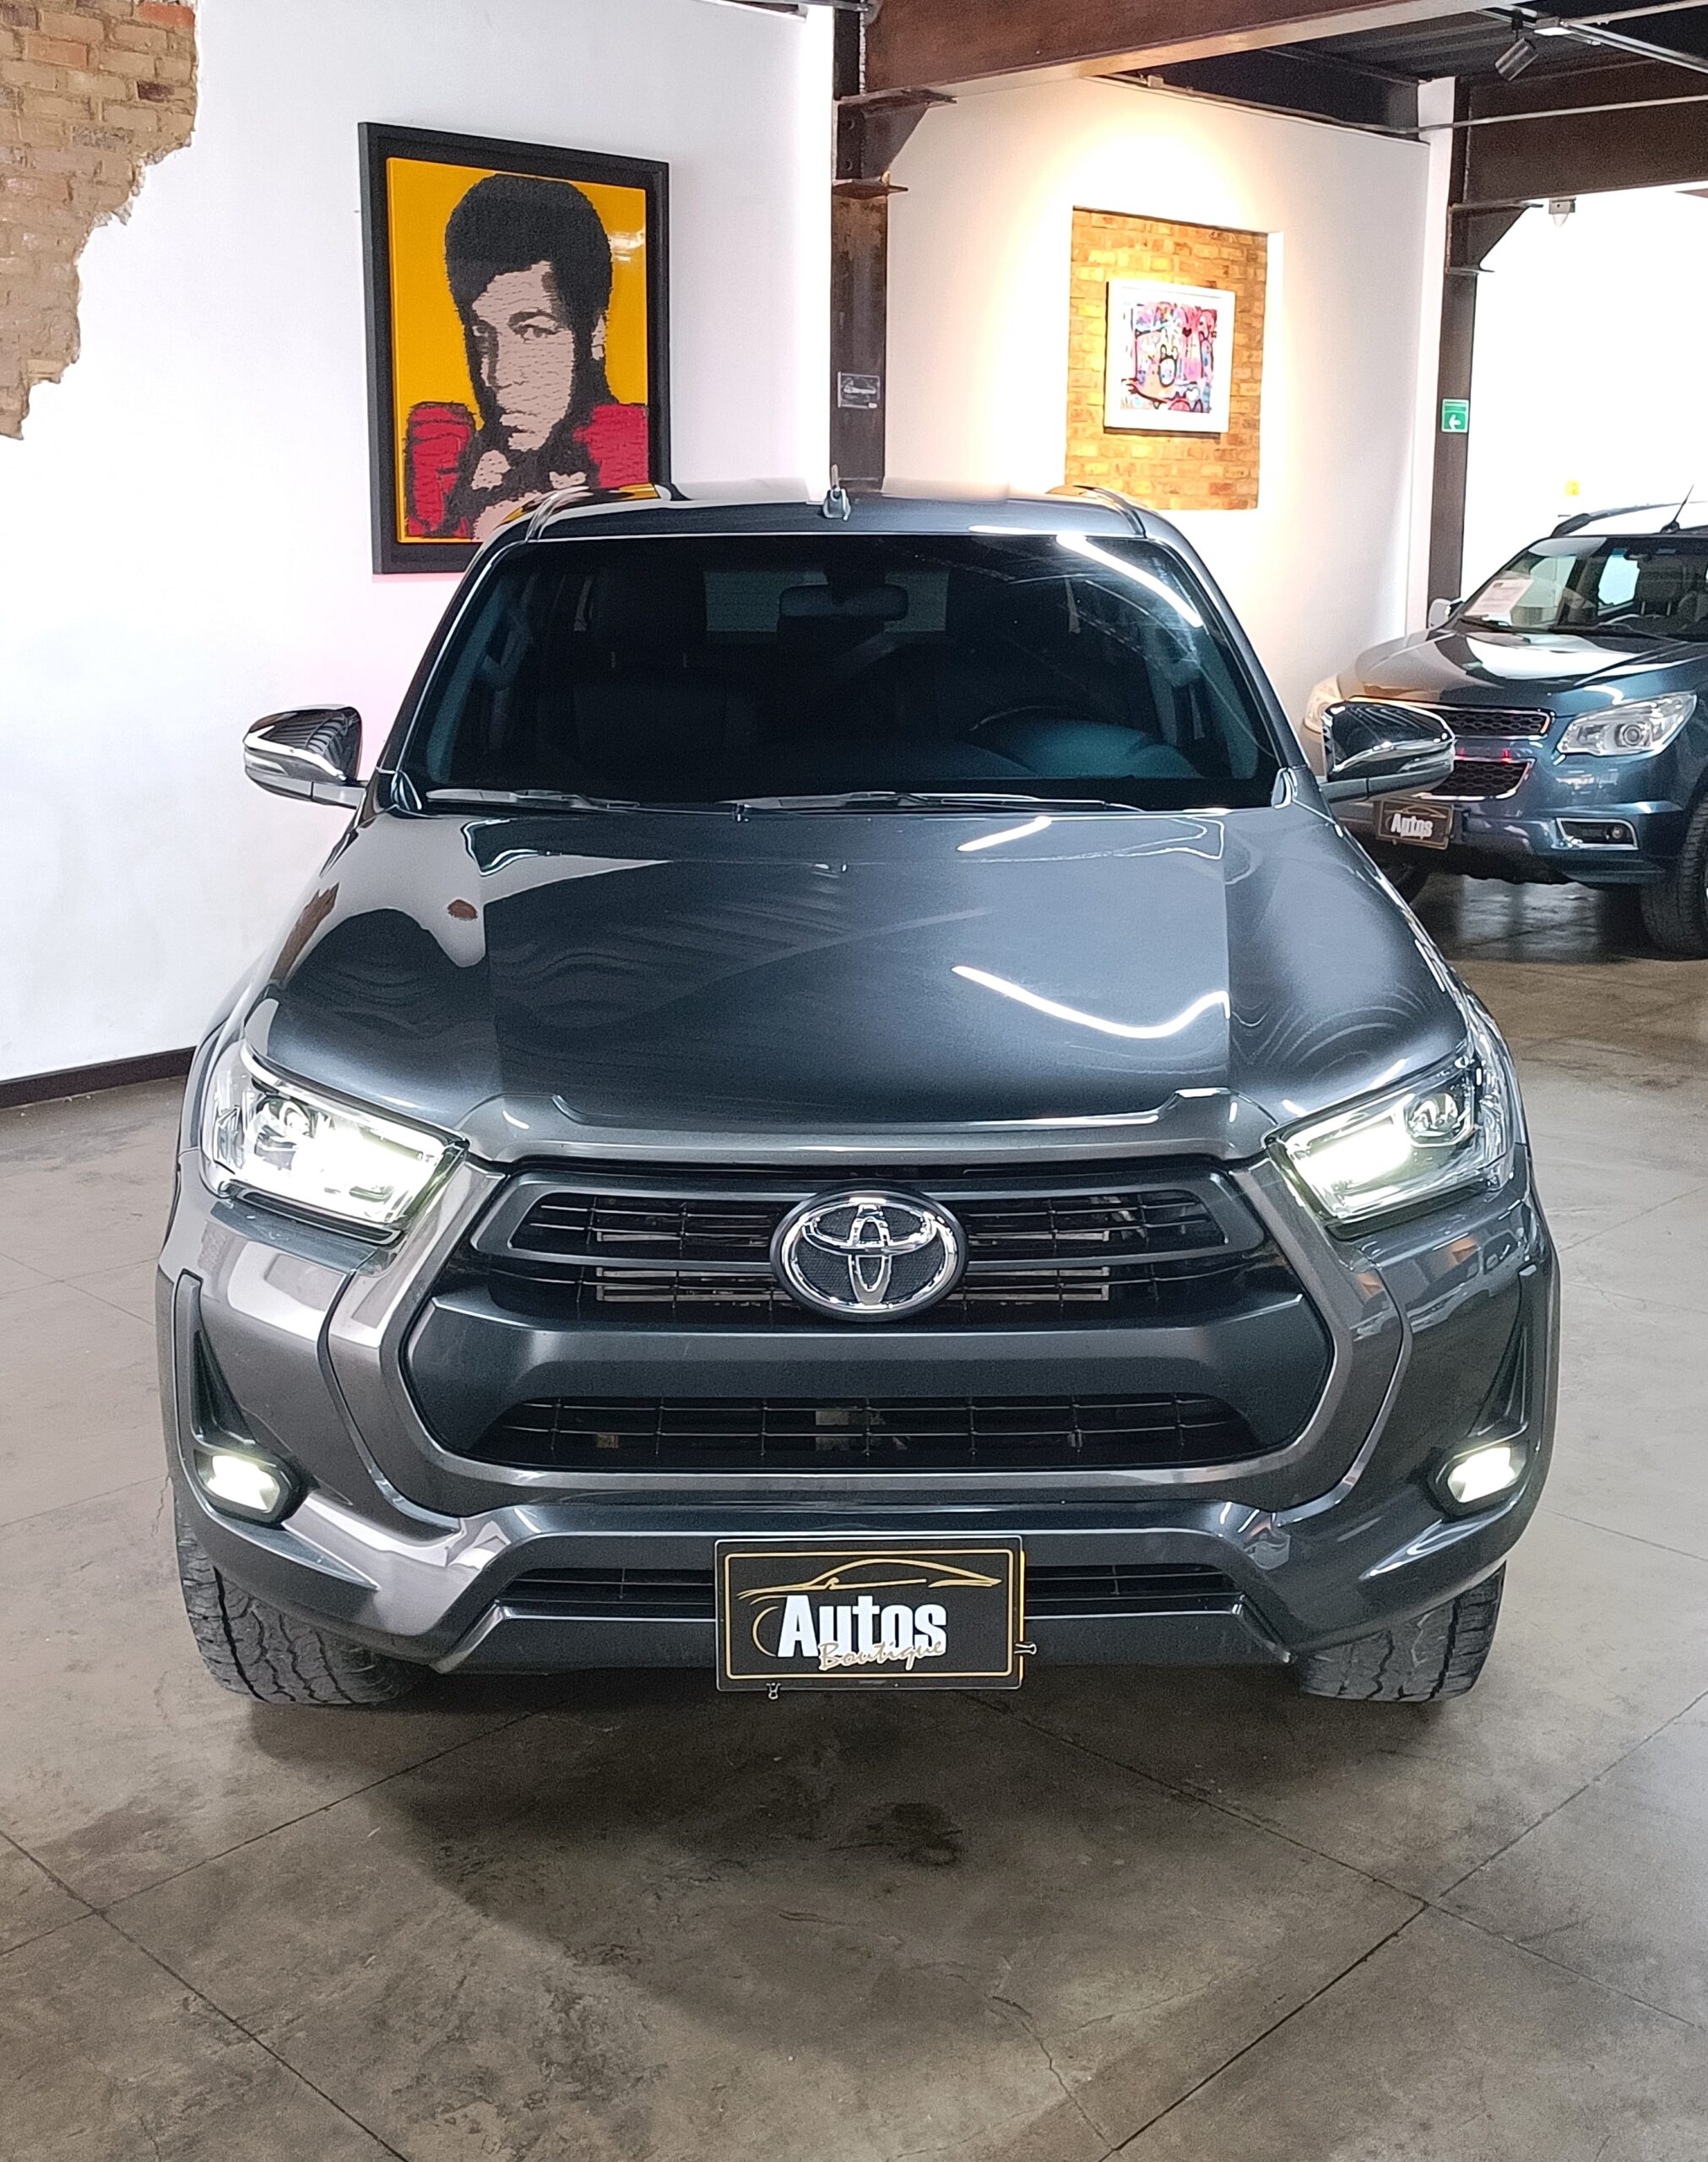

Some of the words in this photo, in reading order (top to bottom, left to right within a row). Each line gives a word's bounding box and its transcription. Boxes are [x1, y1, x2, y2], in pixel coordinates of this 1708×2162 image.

[1391, 812, 1434, 838] Autos
[777, 1594, 947, 1658] Autos
[817, 1640, 946, 1670] Boutique
